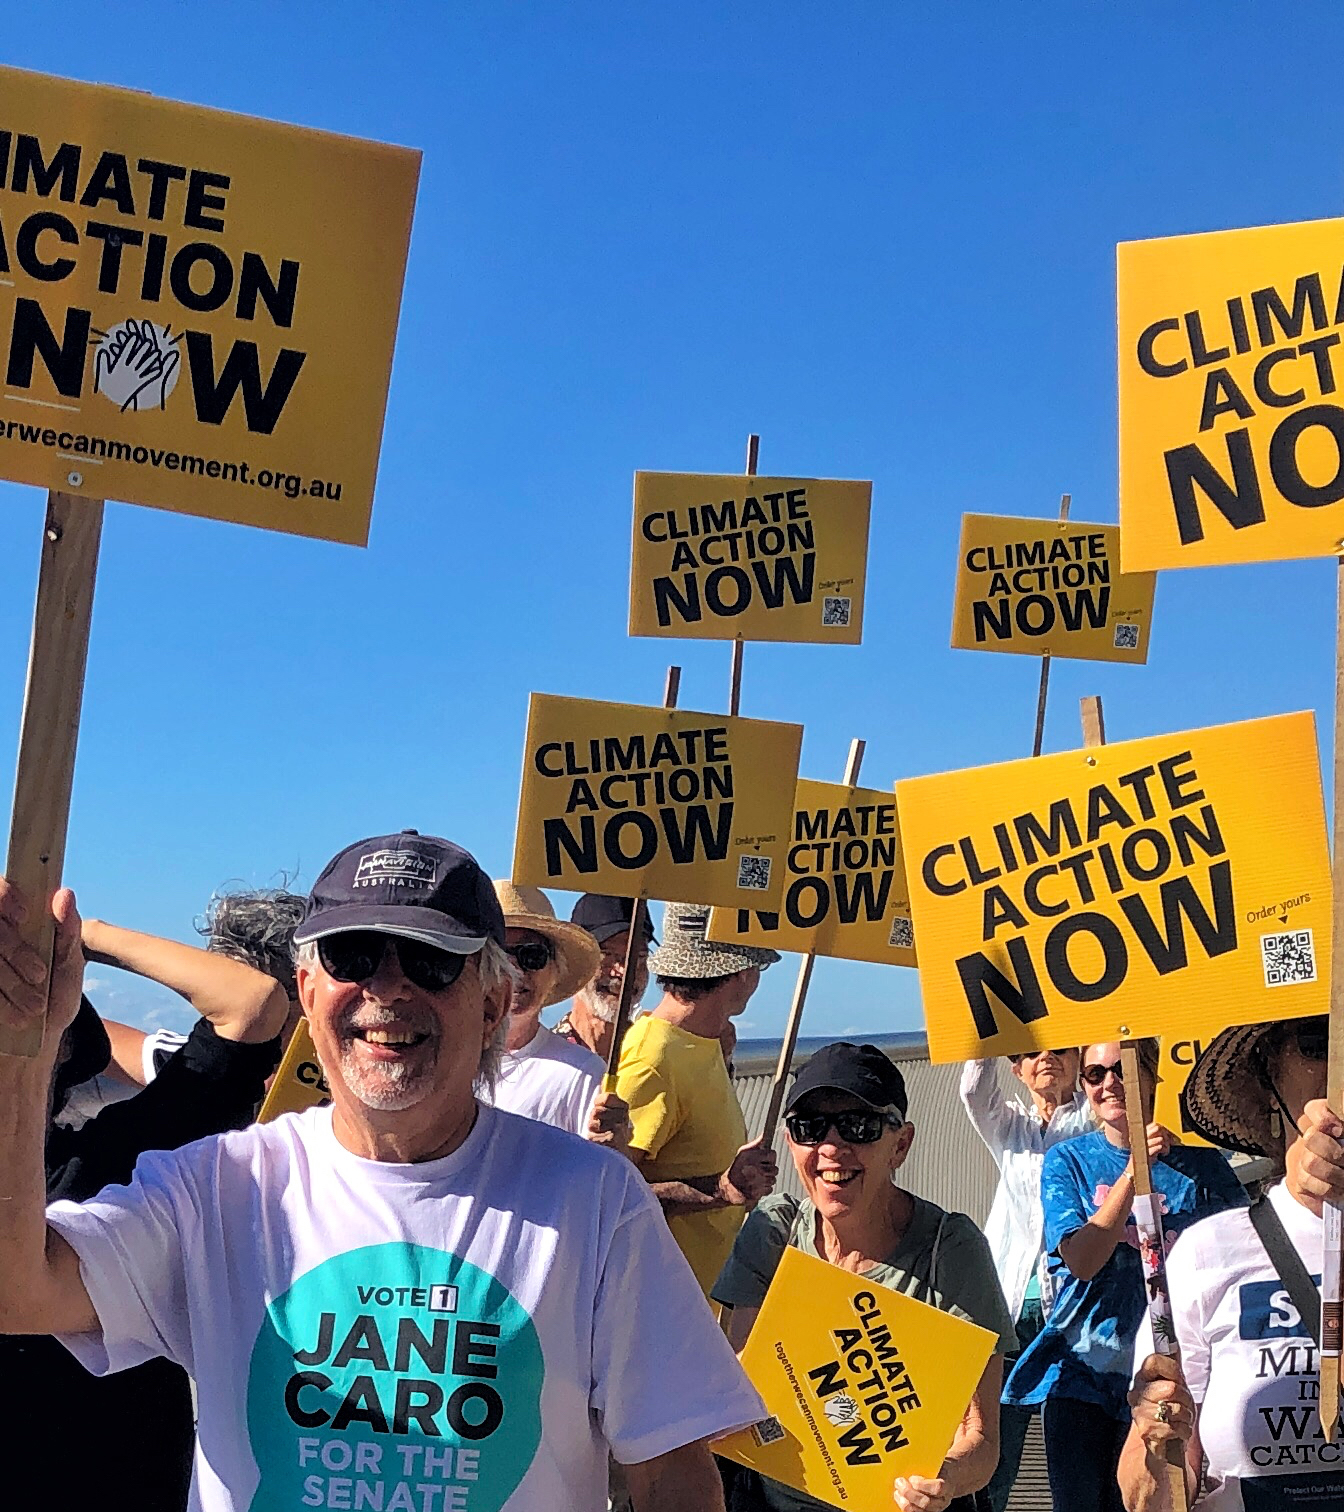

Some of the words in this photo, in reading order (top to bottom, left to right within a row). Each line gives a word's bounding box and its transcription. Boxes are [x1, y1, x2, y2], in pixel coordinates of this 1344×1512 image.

[642, 488, 810, 543] CLIMATE
[671, 520, 815, 572] ACTION
[966, 533, 1106, 573] CLIMATE
[653, 552, 816, 626] NOW
[988, 560, 1110, 597] ACTION
[973, 586, 1111, 642] NOW
[535, 727, 730, 778] CLIMATE
[565, 765, 734, 814] ACTION
[543, 802, 735, 877] NOW
[795, 804, 896, 841] MATE
[921, 750, 1206, 896] CLIMATE
[787, 837, 897, 874] CTION
[982, 804, 1226, 941] ACTION
[352, 877, 435, 890] AUSTRALIA
[1246, 905, 1278, 924] Order
[1280, 891, 1311, 917] yours
[956, 859, 1238, 1040] NOW
[356, 1285, 427, 1307] VOTE
[435, 1288, 450, 1309] 1
[292, 1311, 501, 1381] JANE
[853, 1291, 922, 1414] CLIMATE
[284, 1370, 504, 1441] CARO
[833, 1328, 910, 1453] ACTION
[775, 1341, 849, 1500] togetherwecanmovement.org.au
[298, 1437, 382, 1475] FOR
[396, 1444, 481, 1481] THE
